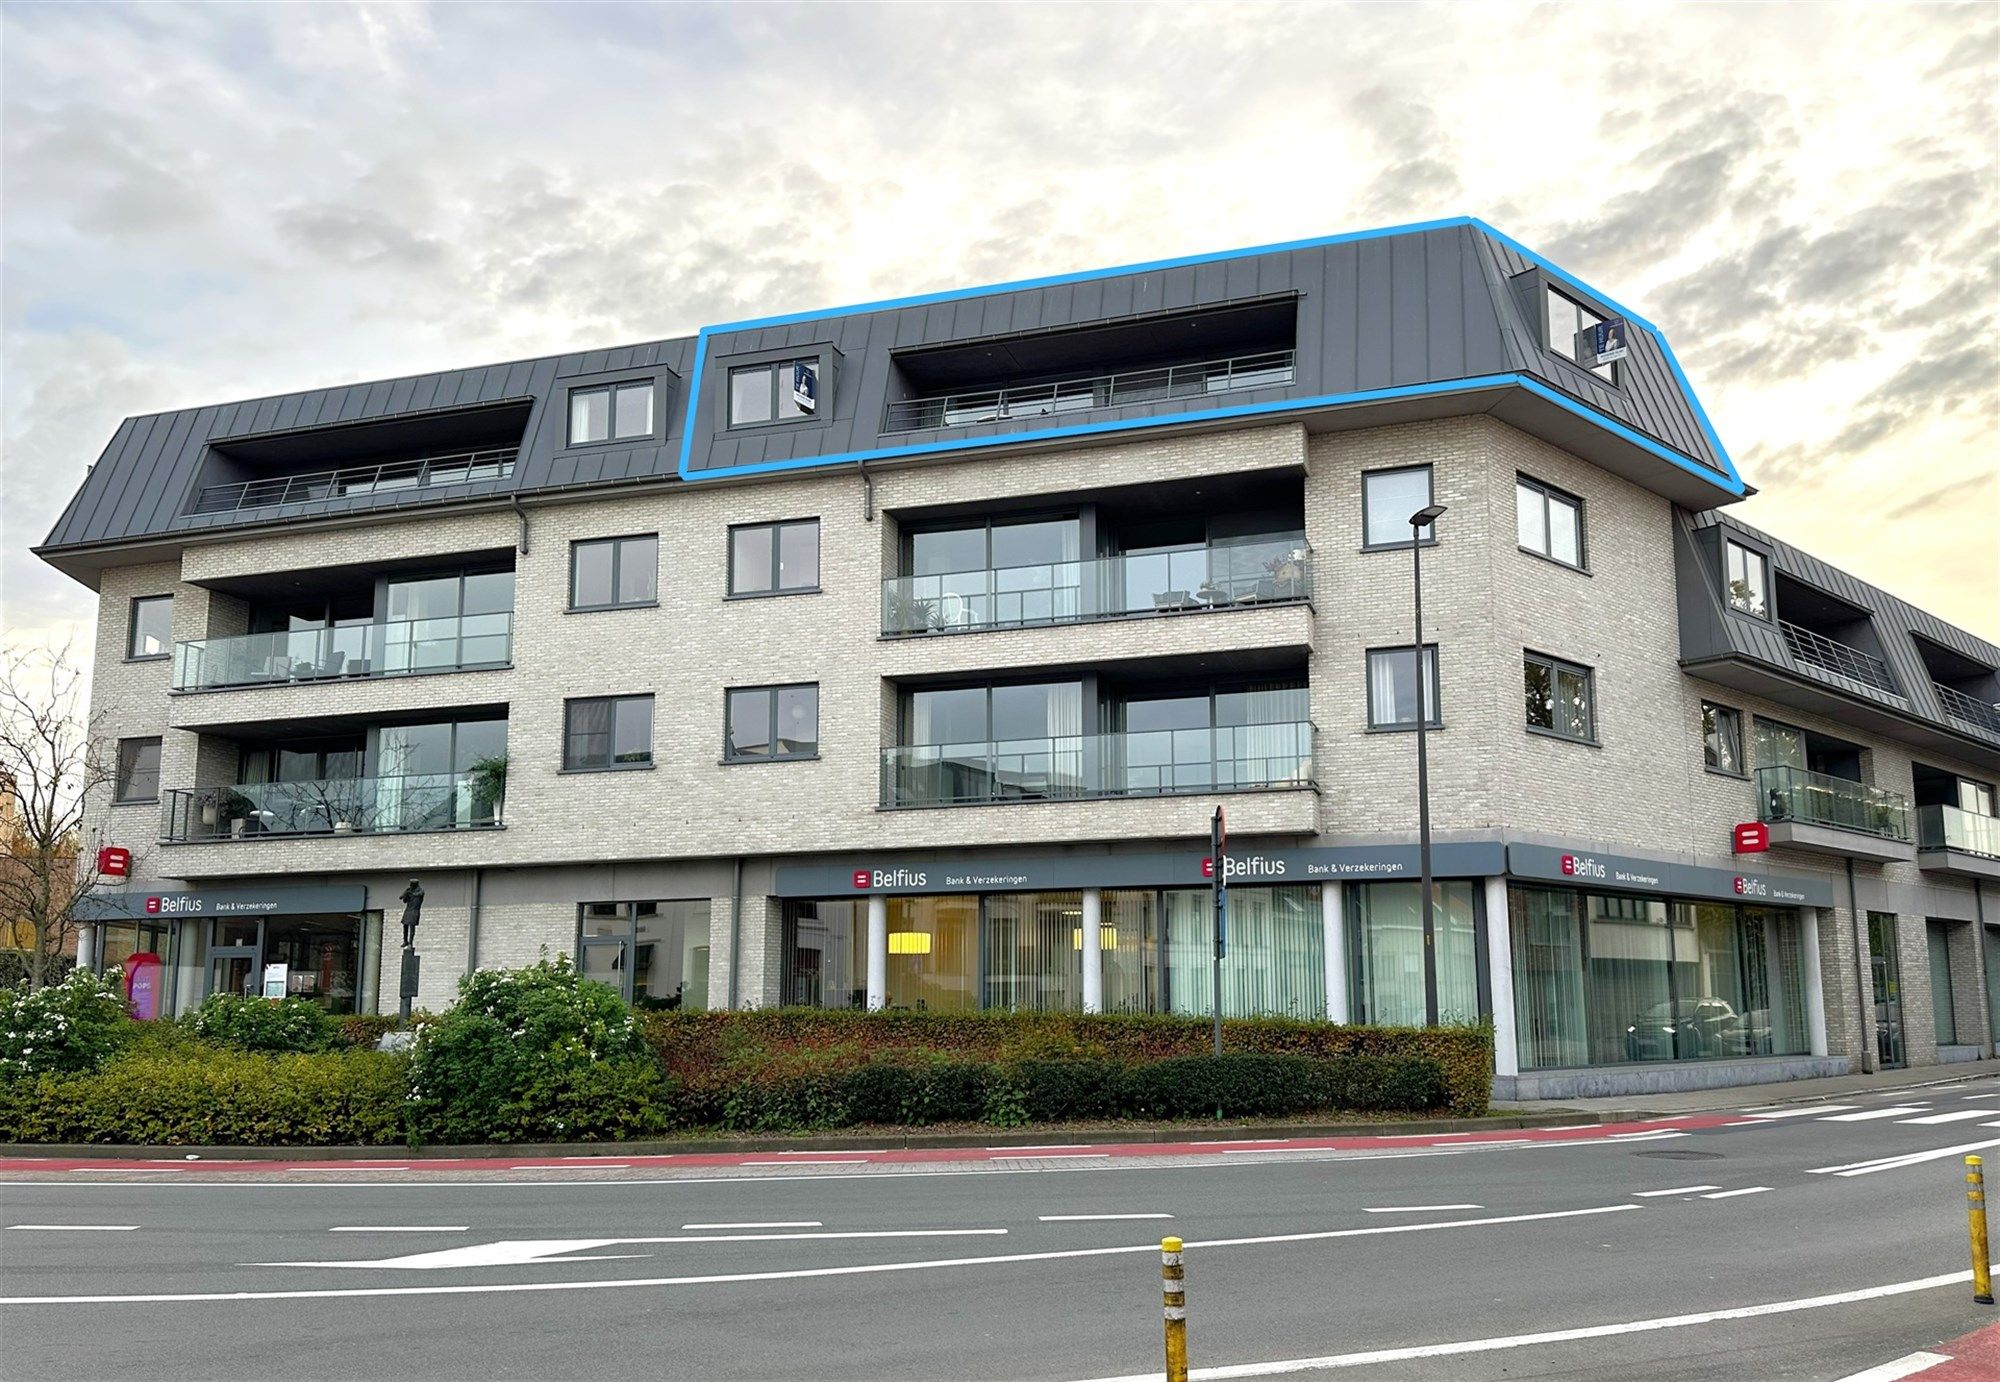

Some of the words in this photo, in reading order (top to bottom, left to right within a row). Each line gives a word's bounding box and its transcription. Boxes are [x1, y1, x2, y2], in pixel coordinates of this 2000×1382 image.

[1223, 856, 1286, 876] Belfius
[1308, 864, 1329, 874] Bank
[1331, 863, 1338, 873] &
[1339, 862, 1403, 874] Verzekeringen
[1573, 856, 1606, 878] Belfius
[1615, 871, 1626, 880] Bank
[873, 869, 927, 888] Belfius
[946, 876, 965, 886] Bank
[965, 875, 971, 885] &
[973, 874, 1028, 885] Verzekeringen
[1742, 878, 1767, 896] Belfius
[161, 896, 202, 913] Belfius
[216, 902, 230, 911] Bank
[230, 902, 235, 910] &
[236, 902, 278, 911] Verzekeringen
